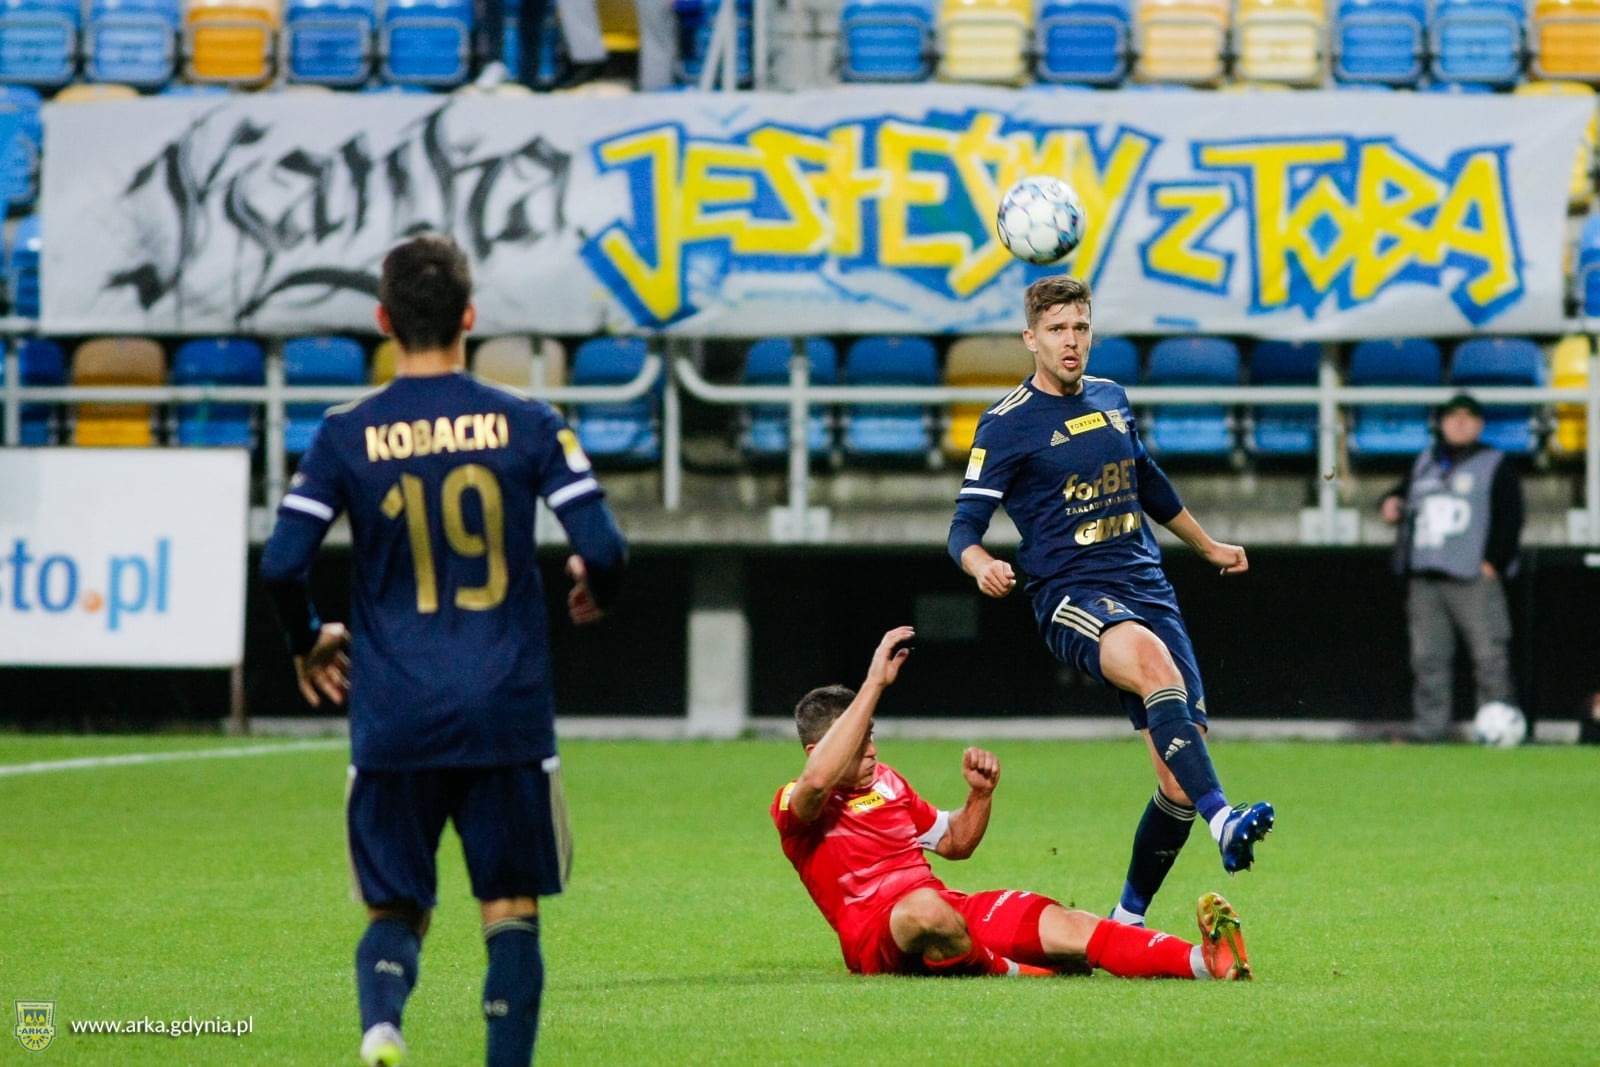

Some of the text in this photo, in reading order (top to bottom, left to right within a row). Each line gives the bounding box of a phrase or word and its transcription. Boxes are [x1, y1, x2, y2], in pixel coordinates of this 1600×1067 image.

[365, 413, 509, 462] KOBACKI
[1070, 417, 1101, 430] FORTUNA
[1063, 458, 1137, 502] forBE
[380, 463, 509, 614] 19
[1074, 511, 1141, 545] GDYN
[0, 537, 171, 632] to.pl
